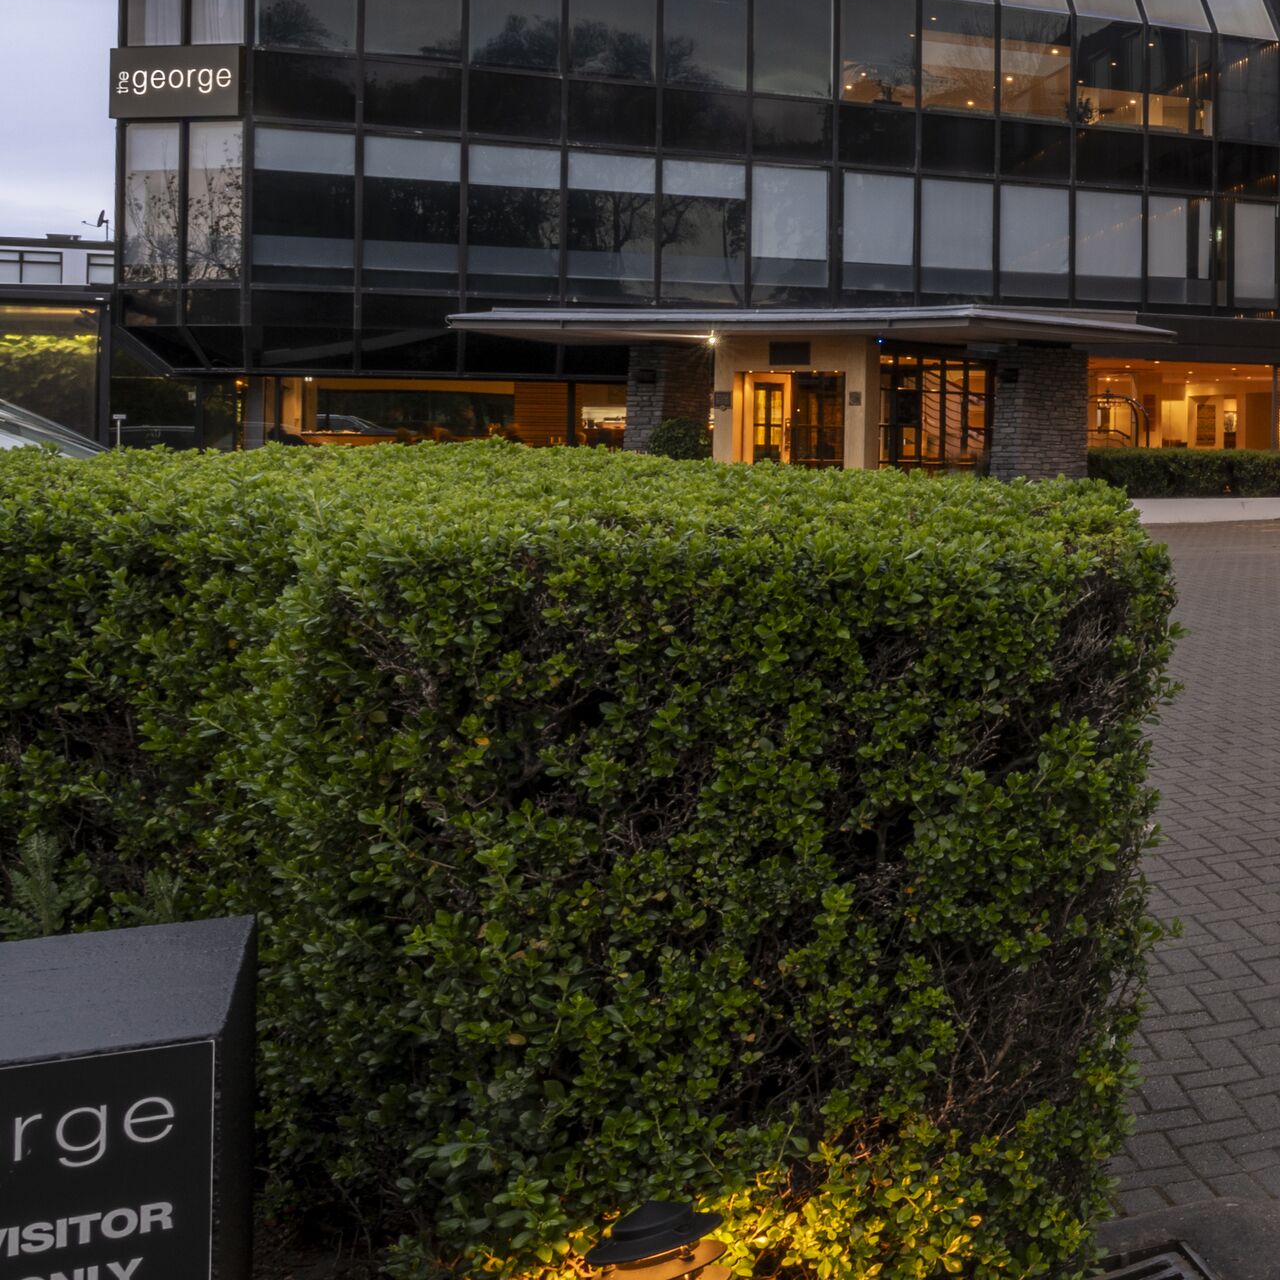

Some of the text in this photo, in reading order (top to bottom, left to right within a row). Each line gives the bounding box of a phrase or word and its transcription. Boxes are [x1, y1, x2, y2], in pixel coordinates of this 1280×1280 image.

[116, 67, 232, 95] the george
[13, 1095, 176, 1168] rge
[0, 1201, 174, 1258] ISITOR
